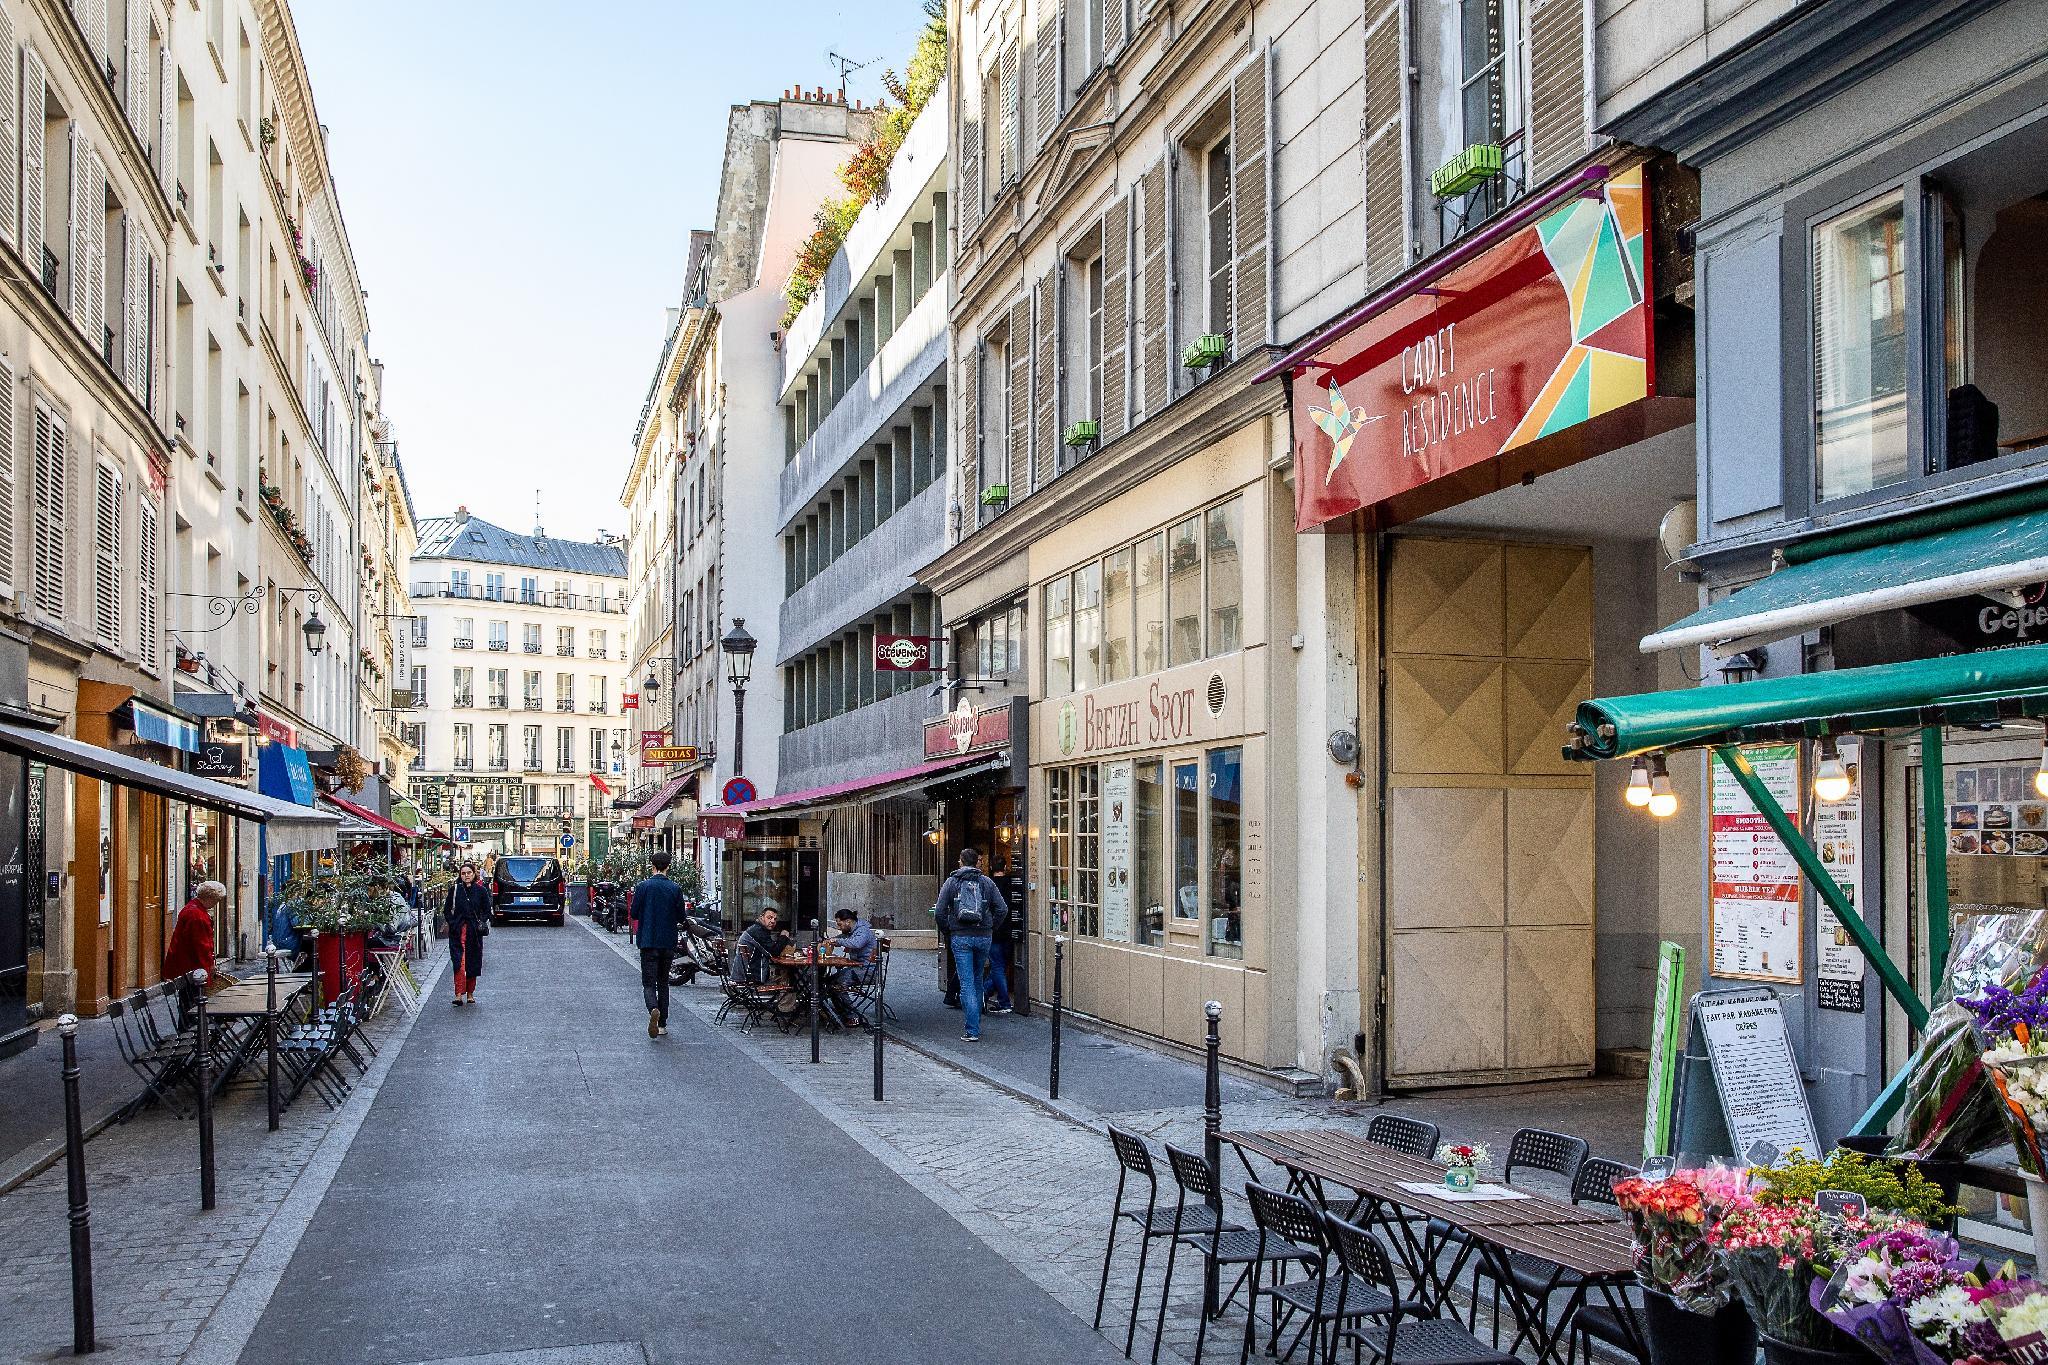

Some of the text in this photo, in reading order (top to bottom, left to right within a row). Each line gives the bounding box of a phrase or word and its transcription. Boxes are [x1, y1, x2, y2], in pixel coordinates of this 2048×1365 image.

[1402, 323, 1456, 395] CADET
[1402, 368, 1497, 457] RESIDENCE
[624, 695, 638, 704] ibis
[1084, 678, 1195, 752] BREIZH SPOT
[649, 750, 692, 759] NICOLAS
[1761, 886, 1776, 894] TEA
[1722, 1011, 1736, 1020] PAR
